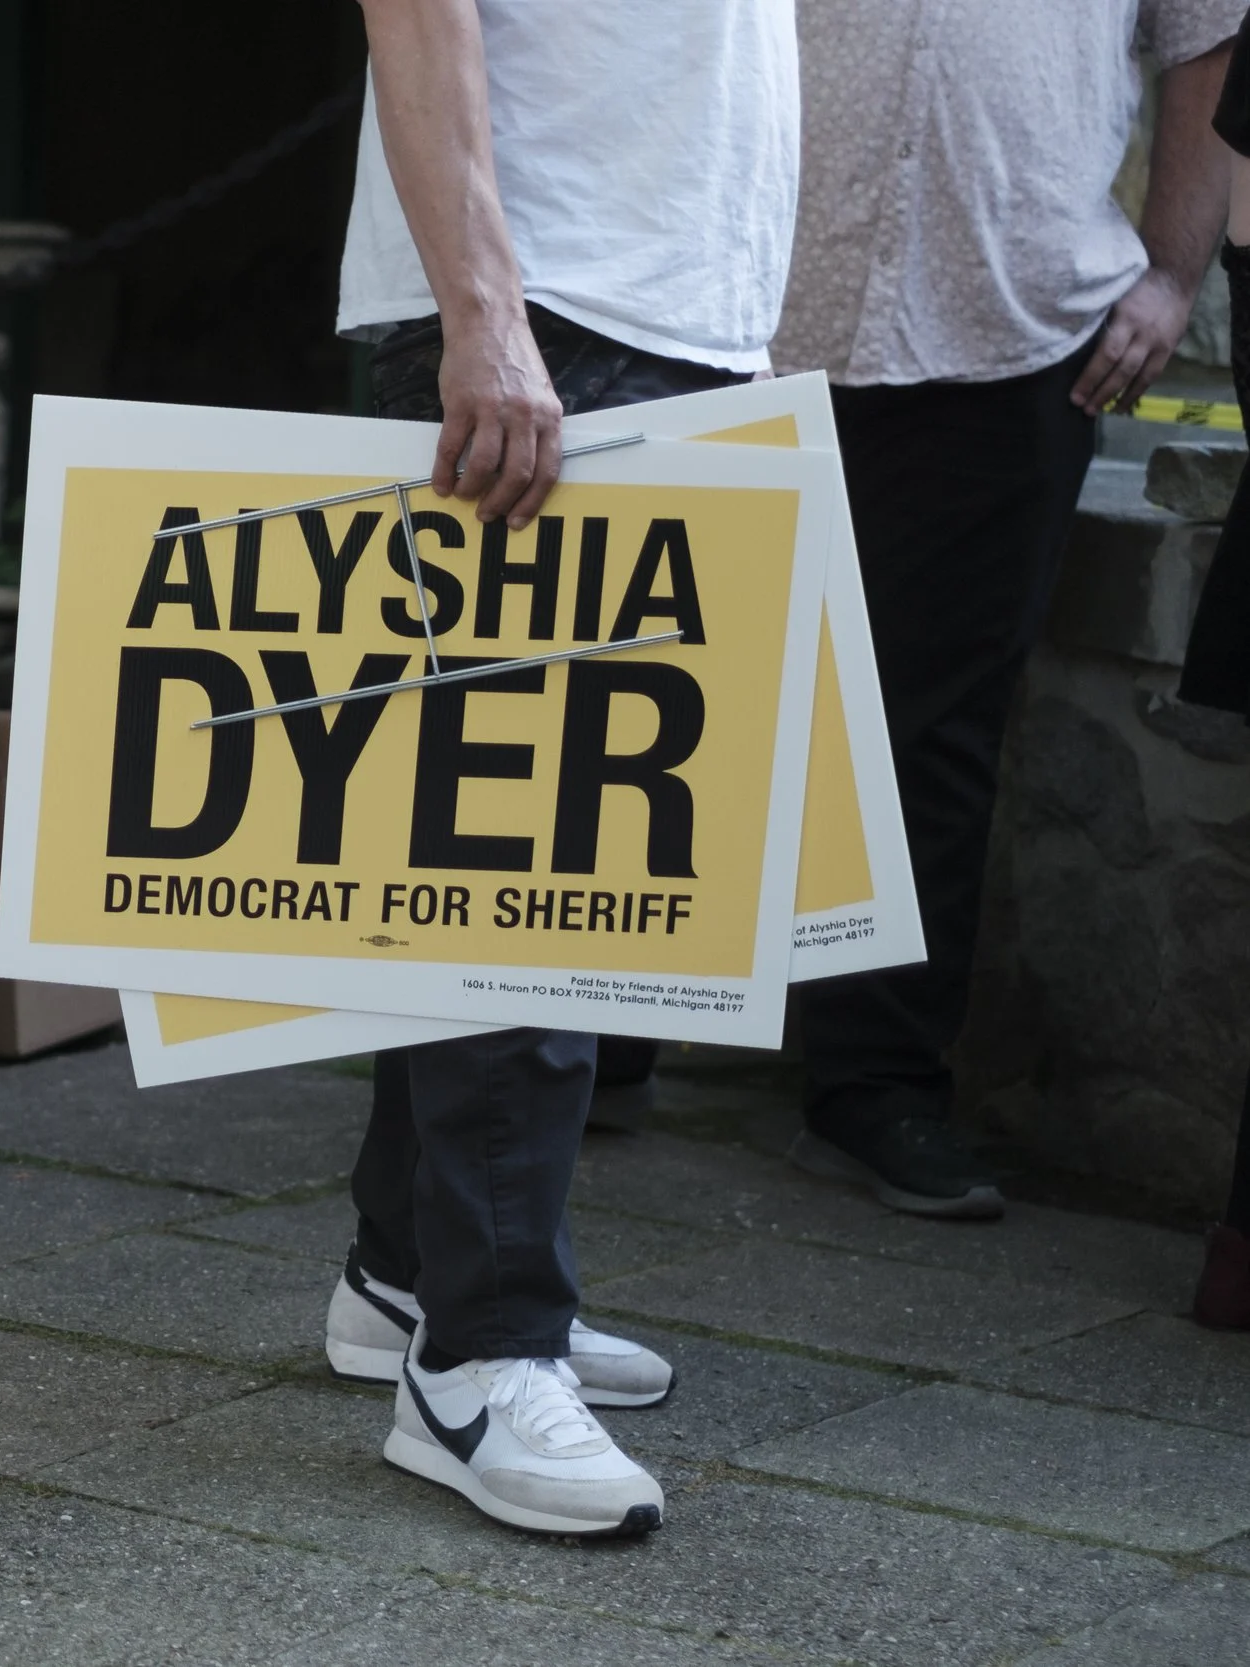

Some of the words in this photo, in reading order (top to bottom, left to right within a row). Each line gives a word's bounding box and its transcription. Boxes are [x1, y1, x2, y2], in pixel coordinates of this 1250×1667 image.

[126, 506, 707, 646] ALYSHIA
[105, 647, 707, 880] DYER
[104, 873, 360, 922] DEMOCRAT
[381, 883, 471, 927] FOR
[493, 887, 692, 935] SHERIFF
[793, 935, 843, 949] Michigan
[845, 927, 875, 940] 48197
[795, 926, 805, 936] of
[809, 920, 847, 934] Alyshia
[848, 917, 873, 928] Dyer
[461, 978, 485, 990] 1606
[488, 981, 496, 991] S.
[500, 982, 529, 994] Huron
[532, 985, 547, 995] PO
[550, 987, 572, 998] BOX
[575, 989, 610, 1001] 972326
[614, 992, 658, 1006] Ypsilanti,
[661, 997, 711, 1011] Michigan
[713, 1002, 744, 1013] 48197
[571, 976, 593, 988] Paid
[595, 978, 610, 988] for
[613, 980, 626, 991] by
[628, 981, 664, 994] Friends
[668, 985, 678, 995] of
[680, 986, 718, 999] Alyshia
[720, 990, 745, 1002] Dyer
